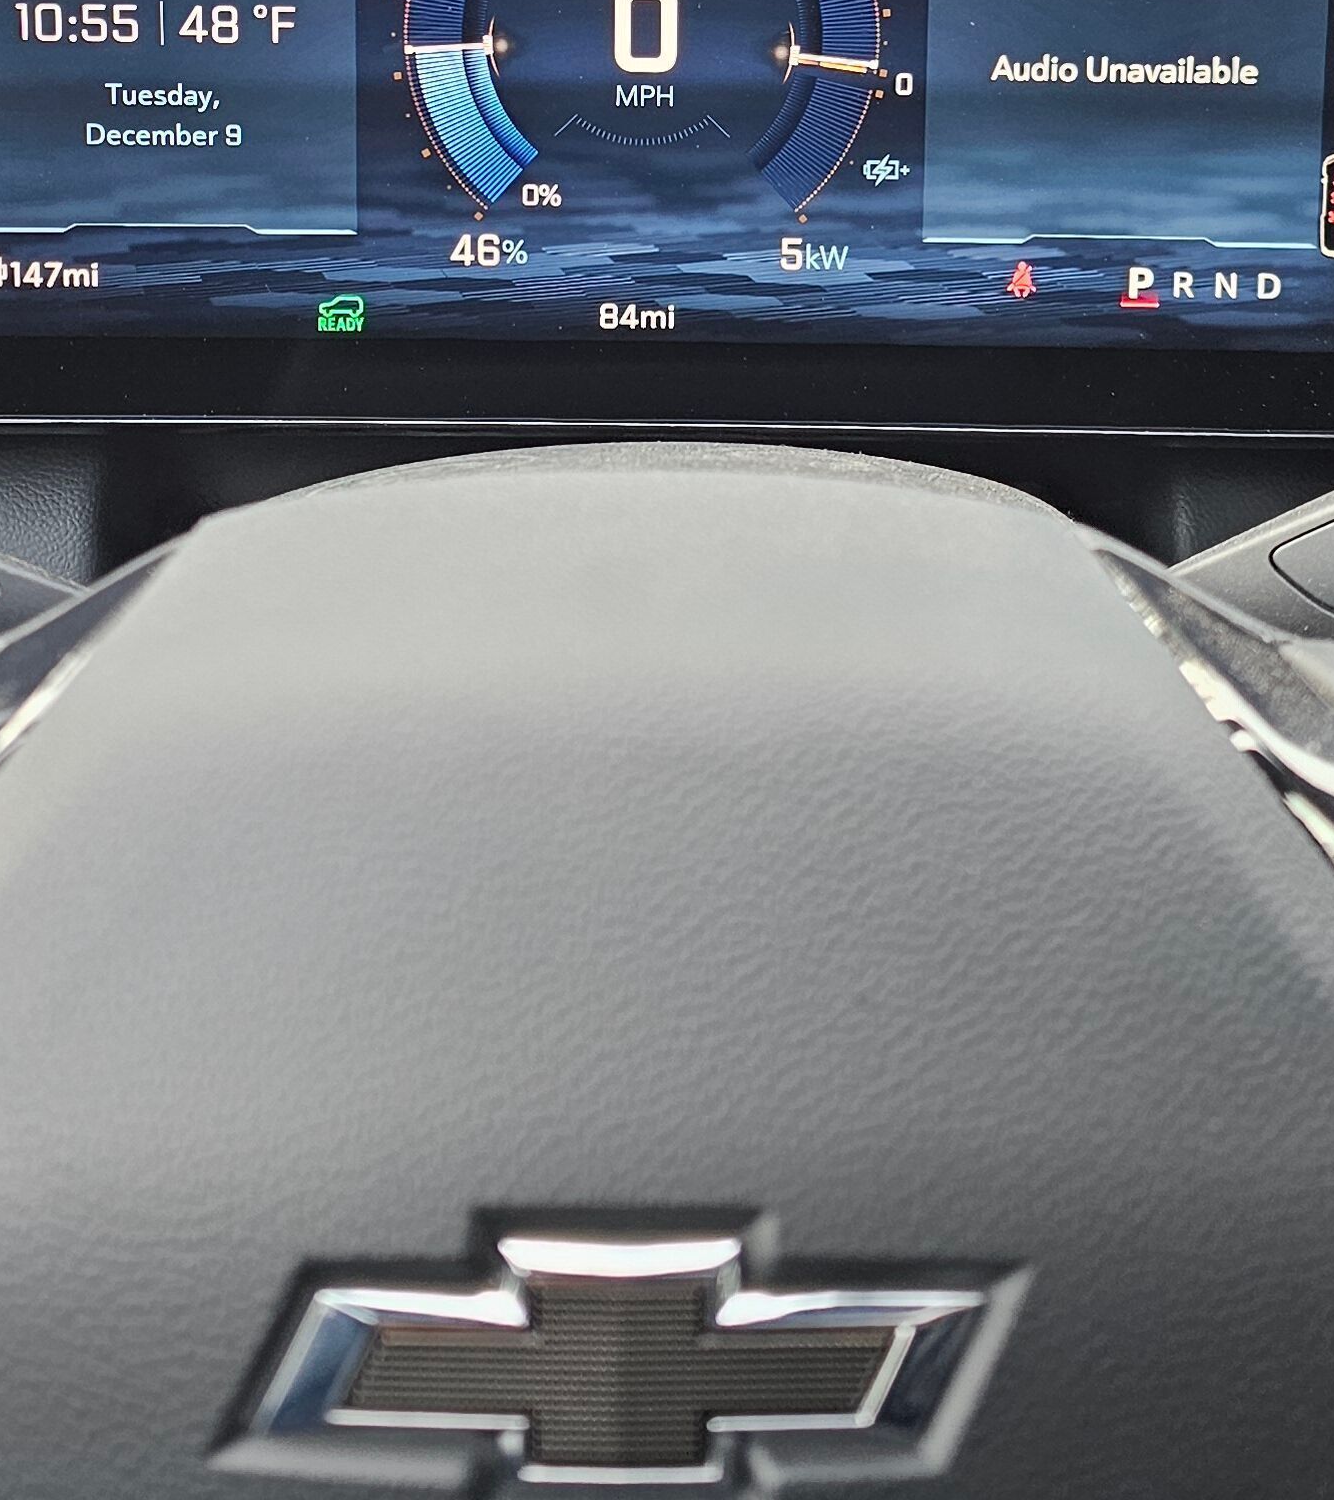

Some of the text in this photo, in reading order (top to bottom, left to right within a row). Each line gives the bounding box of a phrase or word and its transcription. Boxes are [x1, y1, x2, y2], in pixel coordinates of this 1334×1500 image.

[14, 1, 139, 43] 10:55
[178, 3, 240, 45] 48
[894, 72, 914, 97] 0
[990, 55, 1260, 86] Audio Unavailable
[104, 82, 221, 112] Tuesday,
[615, 84, 675, 108] MPH
[85, 122, 243, 147] December 9
[521, 183, 562, 207] 0%
[449, 233, 528, 267] 46%
[778, 237, 850, 271] 5kW
[9, 260, 99, 289] 147mi
[1127, 266, 1283, 299] P R N D
[317, 314, 364, 333] READY
[598, 302, 675, 331] 84mi
